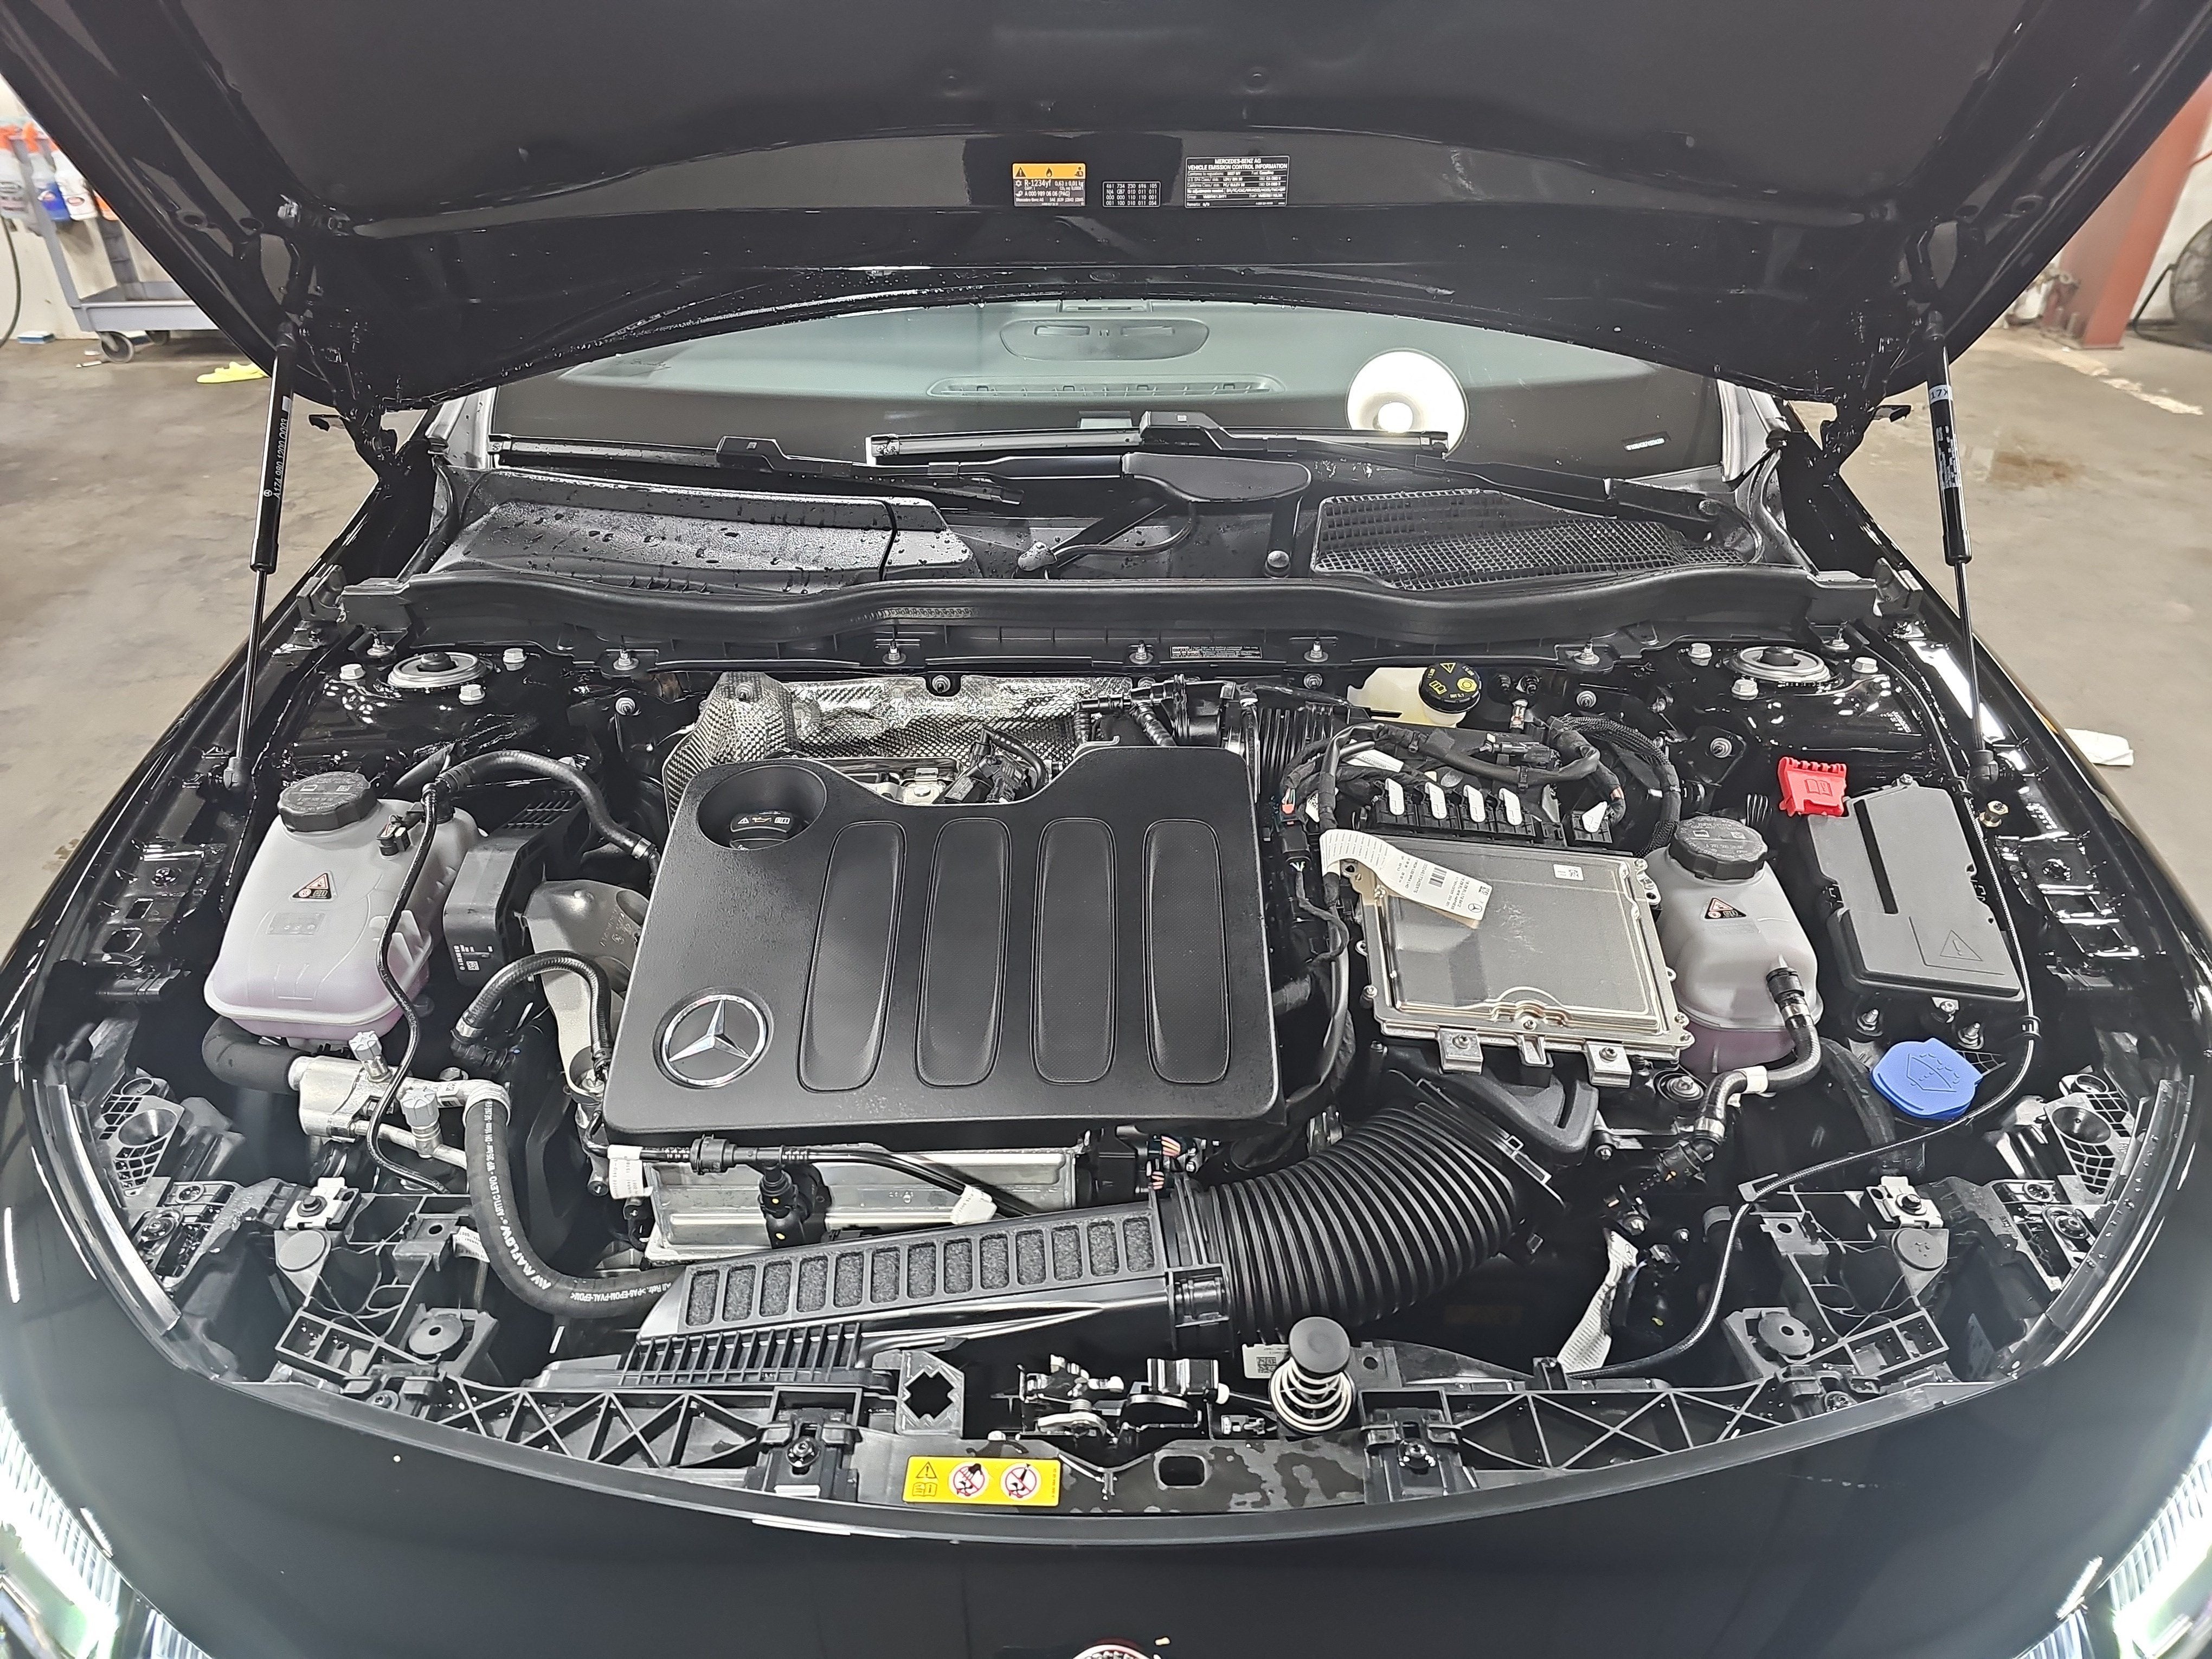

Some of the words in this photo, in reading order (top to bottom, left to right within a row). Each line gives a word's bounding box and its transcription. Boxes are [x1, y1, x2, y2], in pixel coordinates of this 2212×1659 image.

[1024, 179, 1051, 188] R-1234yf
[489, 1176, 500, 1195] LEVO
[492, 1194, 505, 1216] ARTIC
[500, 1225, 536, 1276] MAFLOW
